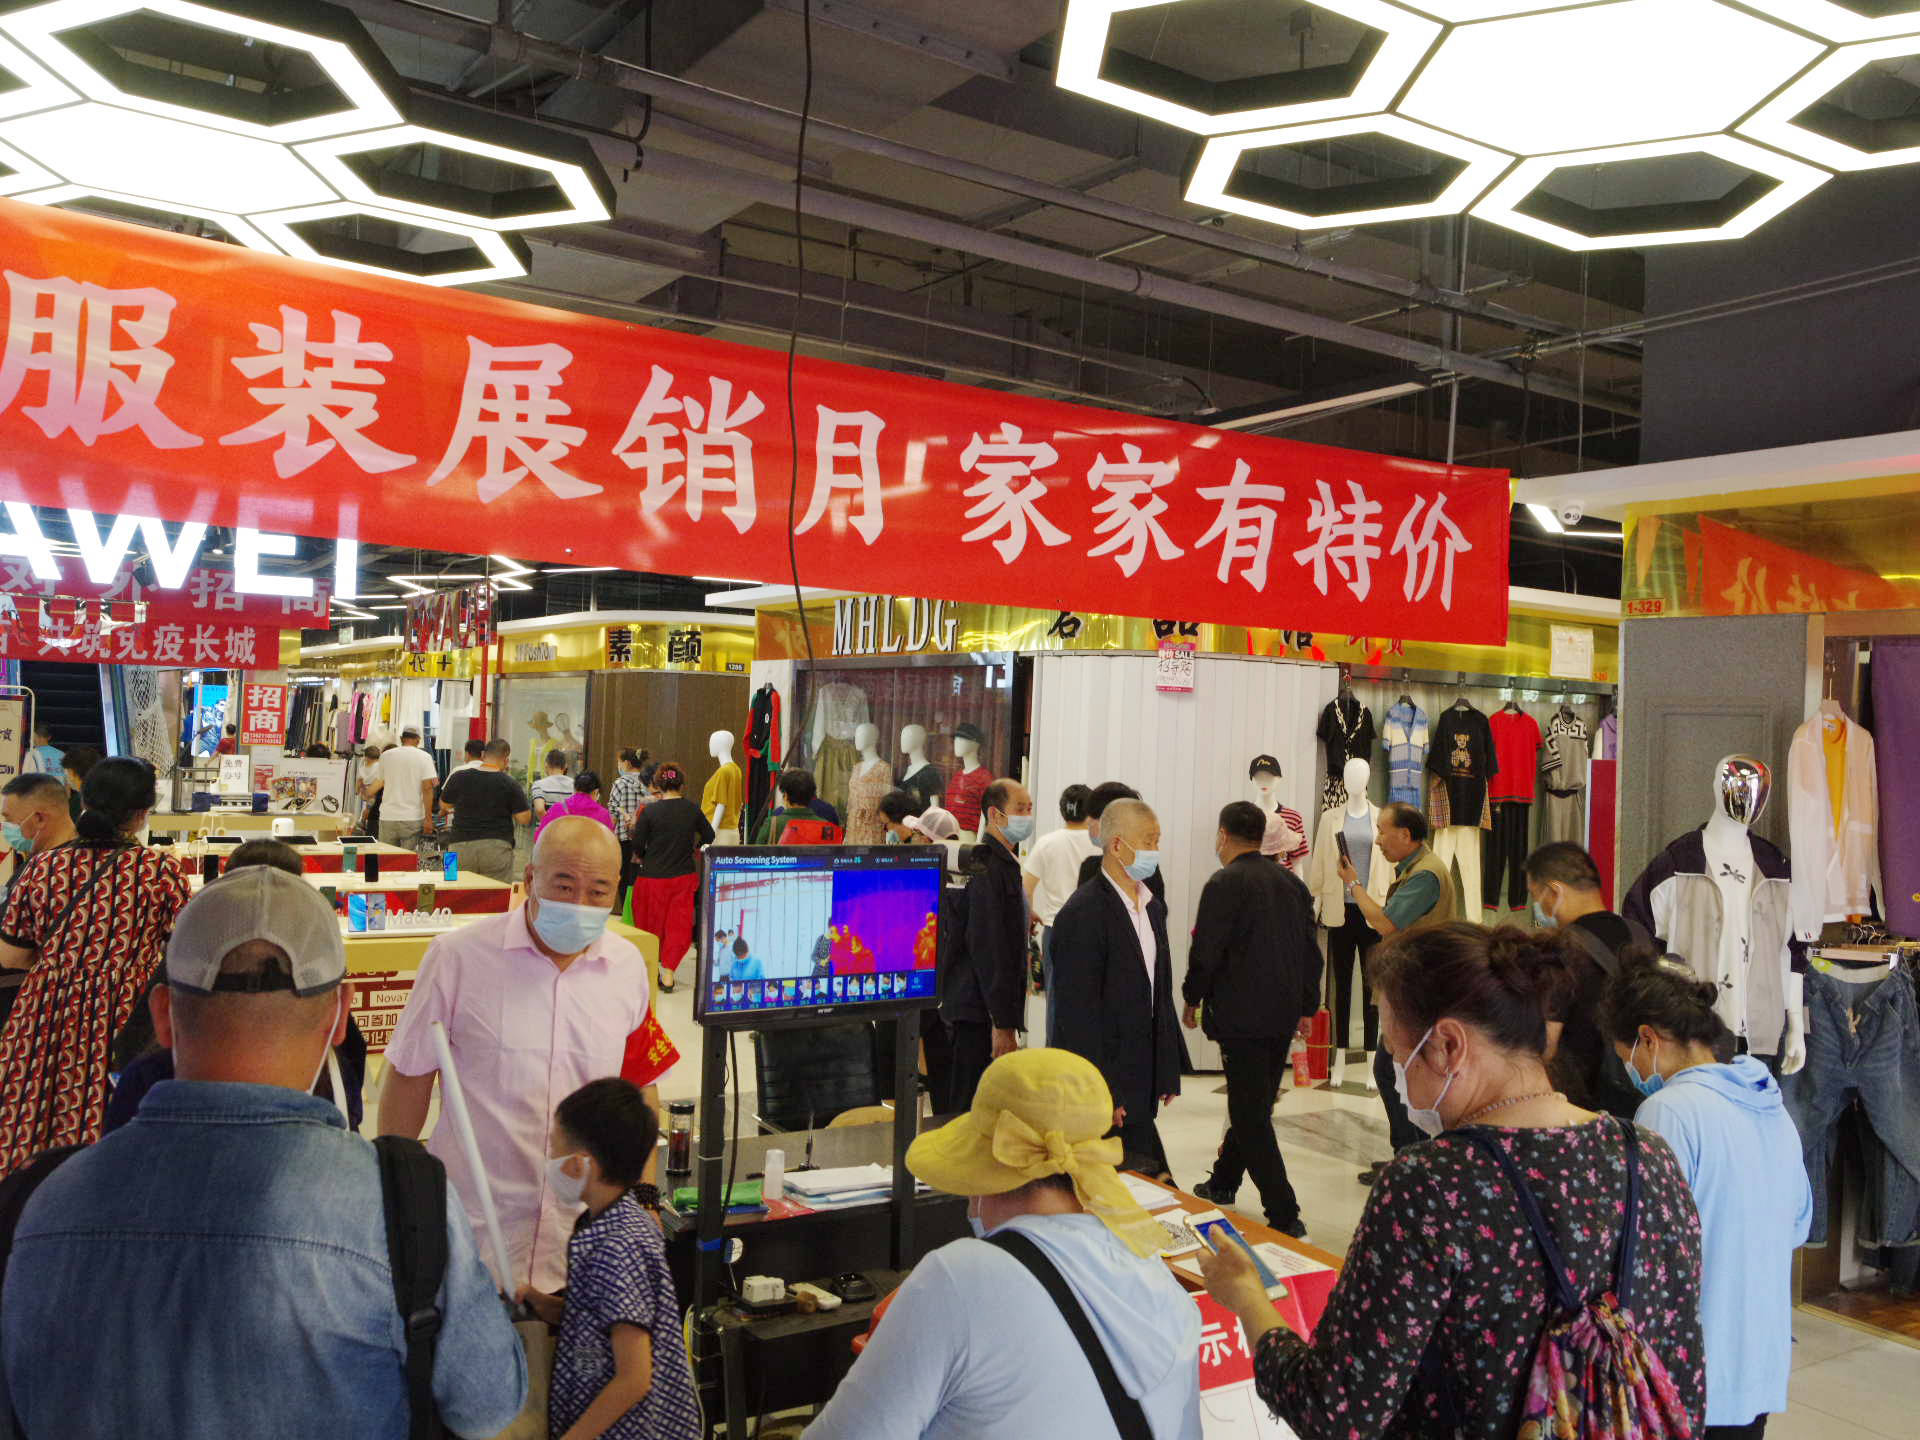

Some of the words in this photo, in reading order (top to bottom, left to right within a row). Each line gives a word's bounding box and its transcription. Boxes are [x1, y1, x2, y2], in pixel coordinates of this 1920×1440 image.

[0, 268, 886, 546] 服装展销月
[960, 422, 1473, 612] 家家有特价
[1627, 600, 1662, 614] 1-329
[832, 595, 959, 655] MHLDG
[609, 629, 703, 663] 素颜
[1175, 650, 1194, 658] SALE
[247, 685, 282, 732] 招商
[715, 856, 734, 864] Auto
[734, 856, 771, 865] Screening
[770, 855, 797, 865] System
